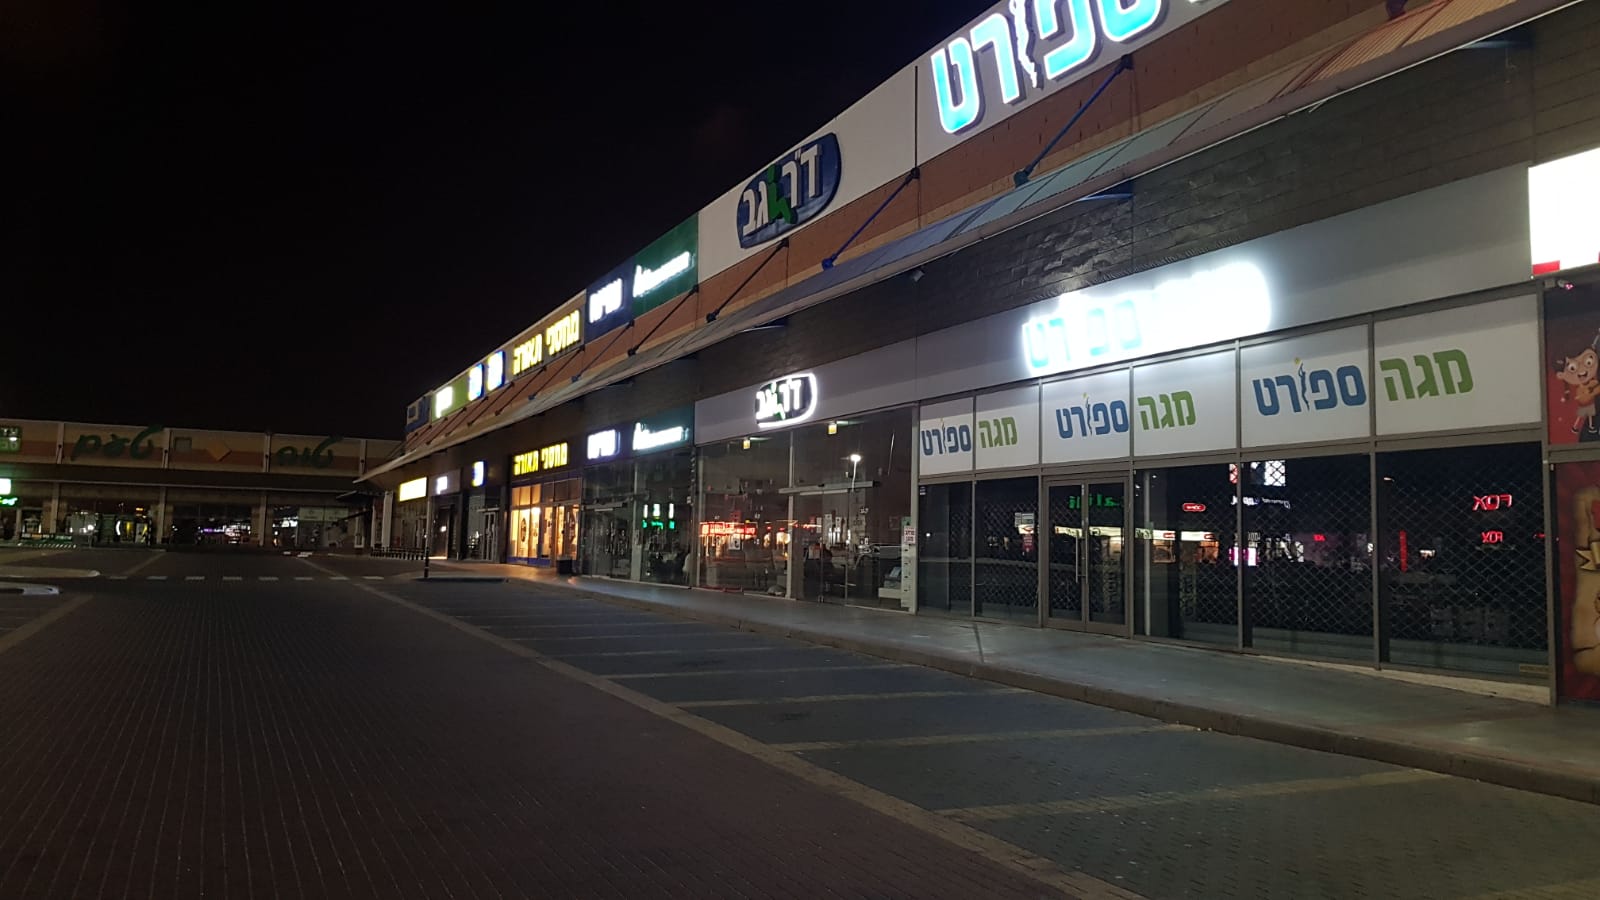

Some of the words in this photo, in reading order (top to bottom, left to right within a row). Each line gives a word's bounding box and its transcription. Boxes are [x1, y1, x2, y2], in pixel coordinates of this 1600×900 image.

[743, 181, 769, 237] גב
[1252, 358, 1367, 416] ספורט
[1379, 349, 1474, 402] מגה
[978, 416, 1018, 449] מגה
[1055, 393, 1129, 439] ספורט
[1137, 390, 1196, 431] מגה
[920, 418, 973, 456] ספורט
